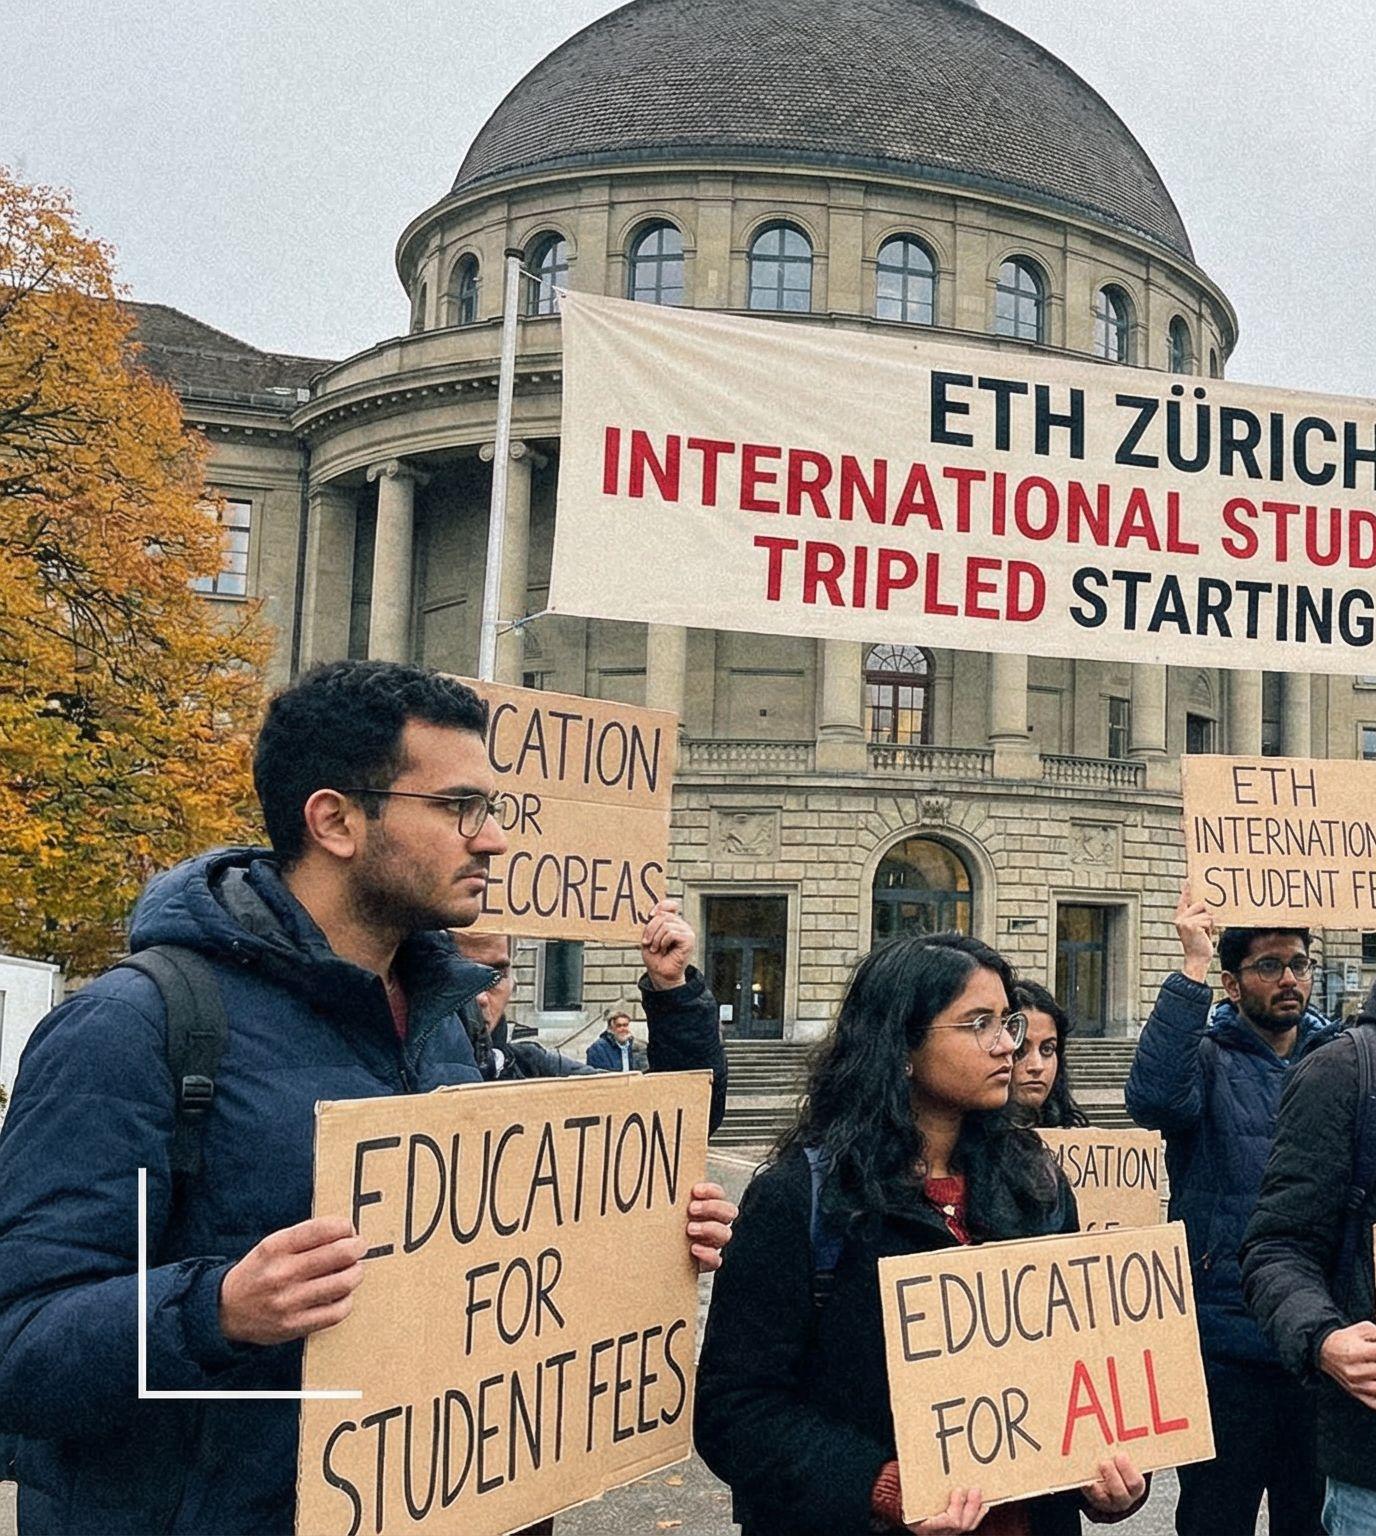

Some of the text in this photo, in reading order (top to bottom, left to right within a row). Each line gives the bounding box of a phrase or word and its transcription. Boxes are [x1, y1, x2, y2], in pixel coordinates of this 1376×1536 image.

[930, 369, 1085, 460] ETH
[602, 426, 1200, 556] INTERNATIONAL
[753, 535, 1047, 622] TRIPLED
[1068, 566, 1375, 648] STARTING
[488, 702, 662, 793] CATION
[1232, 766, 1317, 807] ETH
[493, 790, 543, 836] OR
[1204, 867, 1340, 908] STUDENT
[351, 1108, 684, 1261] EDUCATION
[465, 1247, 566, 1356] FOR
[895, 1245, 1187, 1362] EDUCATION
[322, 1319, 688, 1536] STUDENT FEES
[930, 1349, 1190, 1475] FOR ALL
